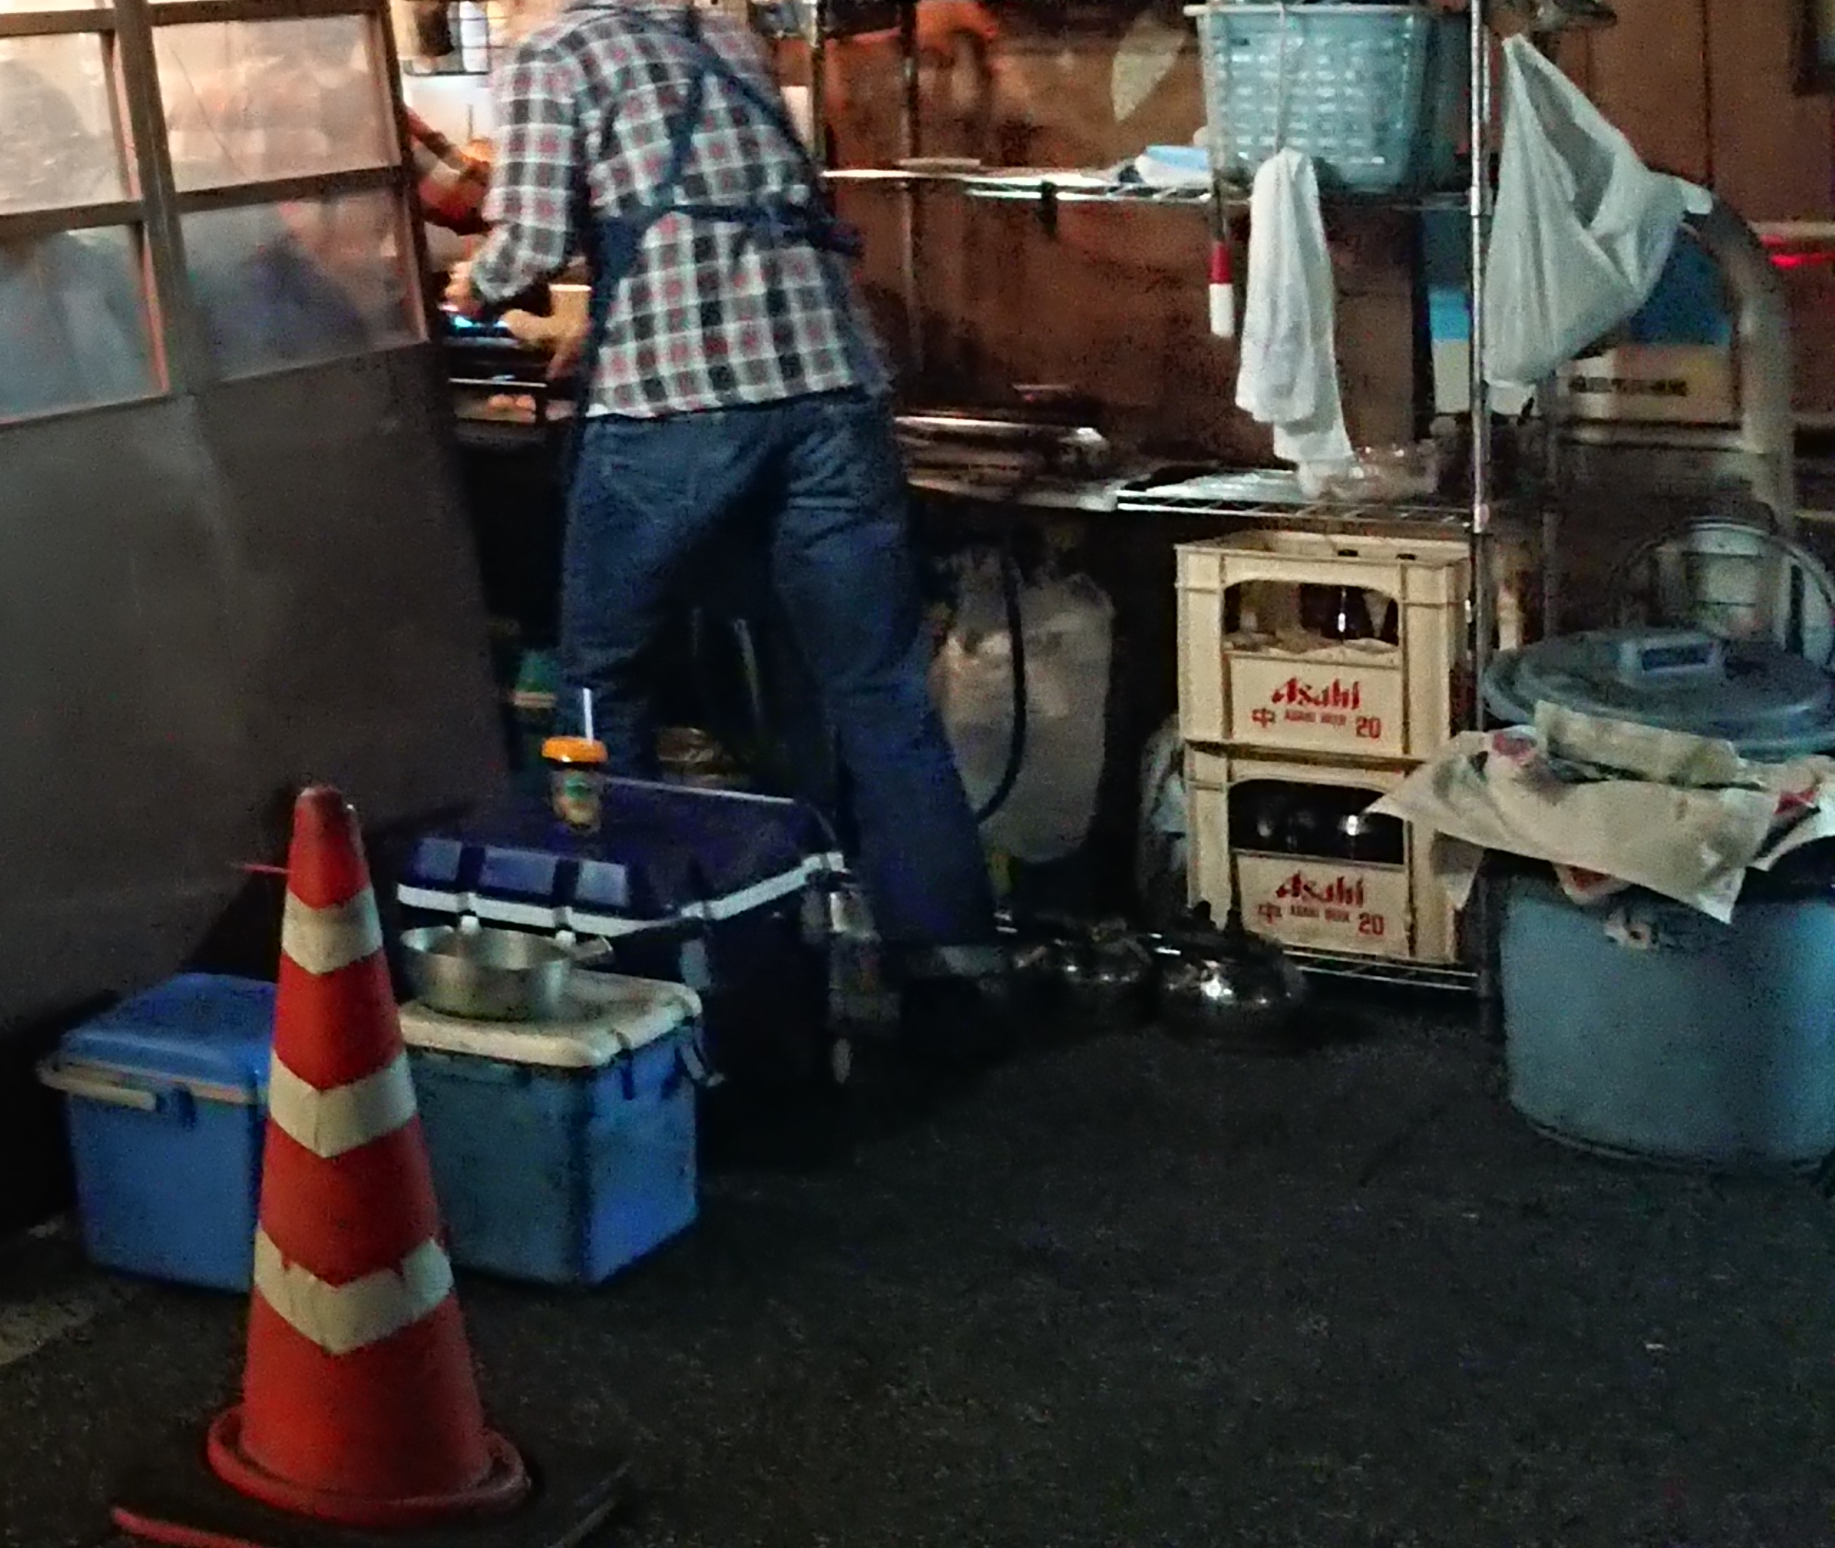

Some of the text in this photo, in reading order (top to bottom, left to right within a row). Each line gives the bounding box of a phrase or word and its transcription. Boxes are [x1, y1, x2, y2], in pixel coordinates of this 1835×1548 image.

[1271, 676, 1360, 710] Asahi
[1355, 715, 1381, 739] 20
[1275, 870, 1364, 908] Asahi
[1358, 912, 1385, 936] 20
